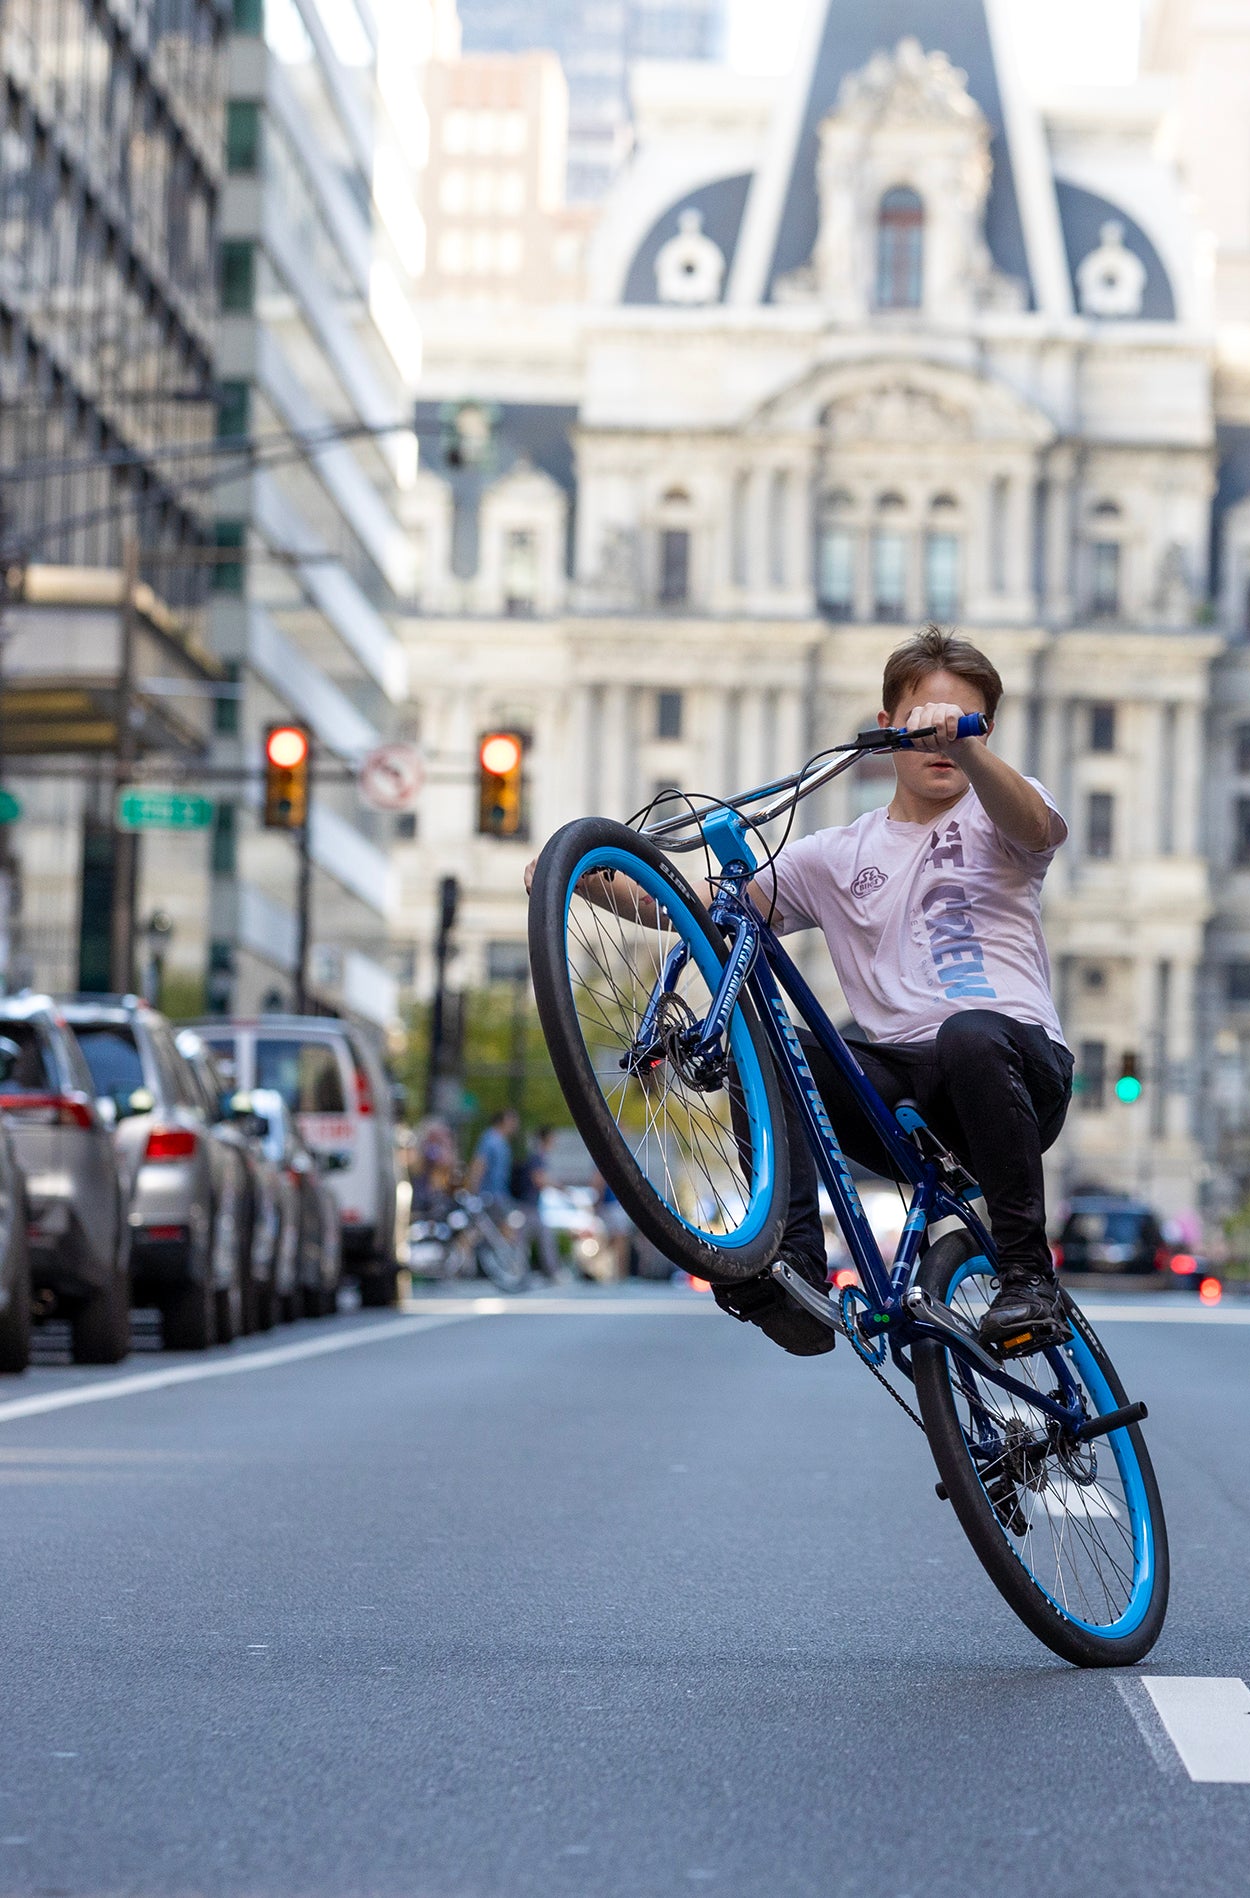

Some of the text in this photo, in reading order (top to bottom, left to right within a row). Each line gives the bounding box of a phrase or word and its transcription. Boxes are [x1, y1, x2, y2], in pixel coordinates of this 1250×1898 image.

[861, 870, 876, 883] SE
[921, 885, 997, 999] CREW
[771, 998, 867, 1219] FAST RIPPER
